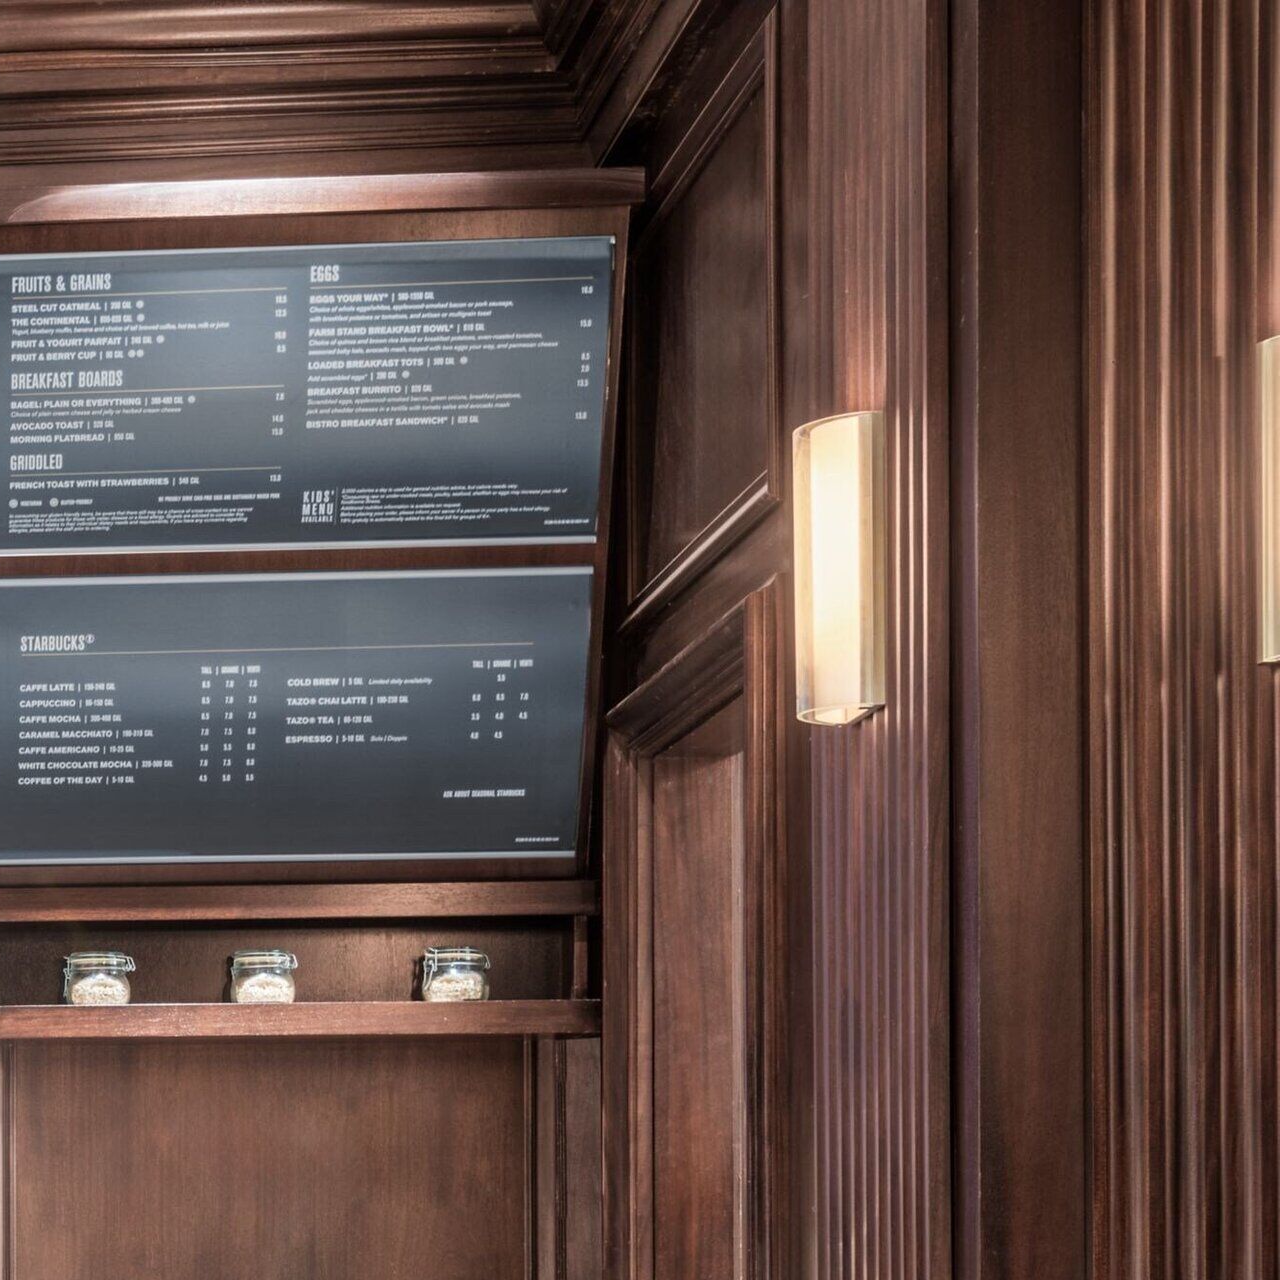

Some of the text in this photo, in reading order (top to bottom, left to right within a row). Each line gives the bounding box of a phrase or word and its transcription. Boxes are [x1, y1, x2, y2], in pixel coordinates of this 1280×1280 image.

[310, 265, 339, 282] EGGS
[12, 273, 111, 293] FRUITS & GRAINS
[309, 294, 362, 304] EGGS YOUR
[12, 302, 101, 313] STEEL CUT OATMEAL
[11, 316, 90, 326] THE CONTINENTAL
[308, 325, 422, 337] FARM STAND BREAKFAST
[11, 340, 37, 348] FRUIT
[46, 338, 83, 347] YOGURT
[84, 336, 122, 346] PARFAIT
[11, 351, 97, 362] FRUIT & BERRY CUP
[308, 358, 424, 370] LOADED BREAKFAST TOTS
[11, 370, 123, 389] BREAKFAST BOARDS
[307, 385, 401, 396] BREAKFAST BURRITO
[44, 400, 70, 408] PLAIN
[71, 399, 84, 407] OR
[86, 397, 141, 407] EVERYTHING
[10, 421, 84, 431] AVOCADO TOAST
[306, 418, 394, 428] BISTRO BREAKFAST
[10, 433, 105, 444] MORNING FLATBREAD
[10, 454, 63, 470] GRIDDLED
[10, 481, 45, 490] FRENCH
[46, 480, 75, 488] TOAST
[100, 477, 169, 487] STRAWBERRIES
[302, 502, 334, 516] MENU
[287, 678, 339, 686] COLD BREW
[20, 683, 74, 692] CAFFE LATTE
[19, 699, 76, 708] CAPPUCCINO
[318, 696, 367, 705] CHAI LATTE
[49, 715, 81, 723] MOCHA
[317, 716, 334, 724] TEA
[19, 730, 113, 739] CARAMEL MACCHIATO
[286, 735, 333, 743] ESPRESSO
[48, 746, 100, 754] AMERICANO
[18, 762, 46, 770] WHITE
[47, 761, 98, 769] CHOCOLATE
[18, 777, 52, 785] COFFEE
